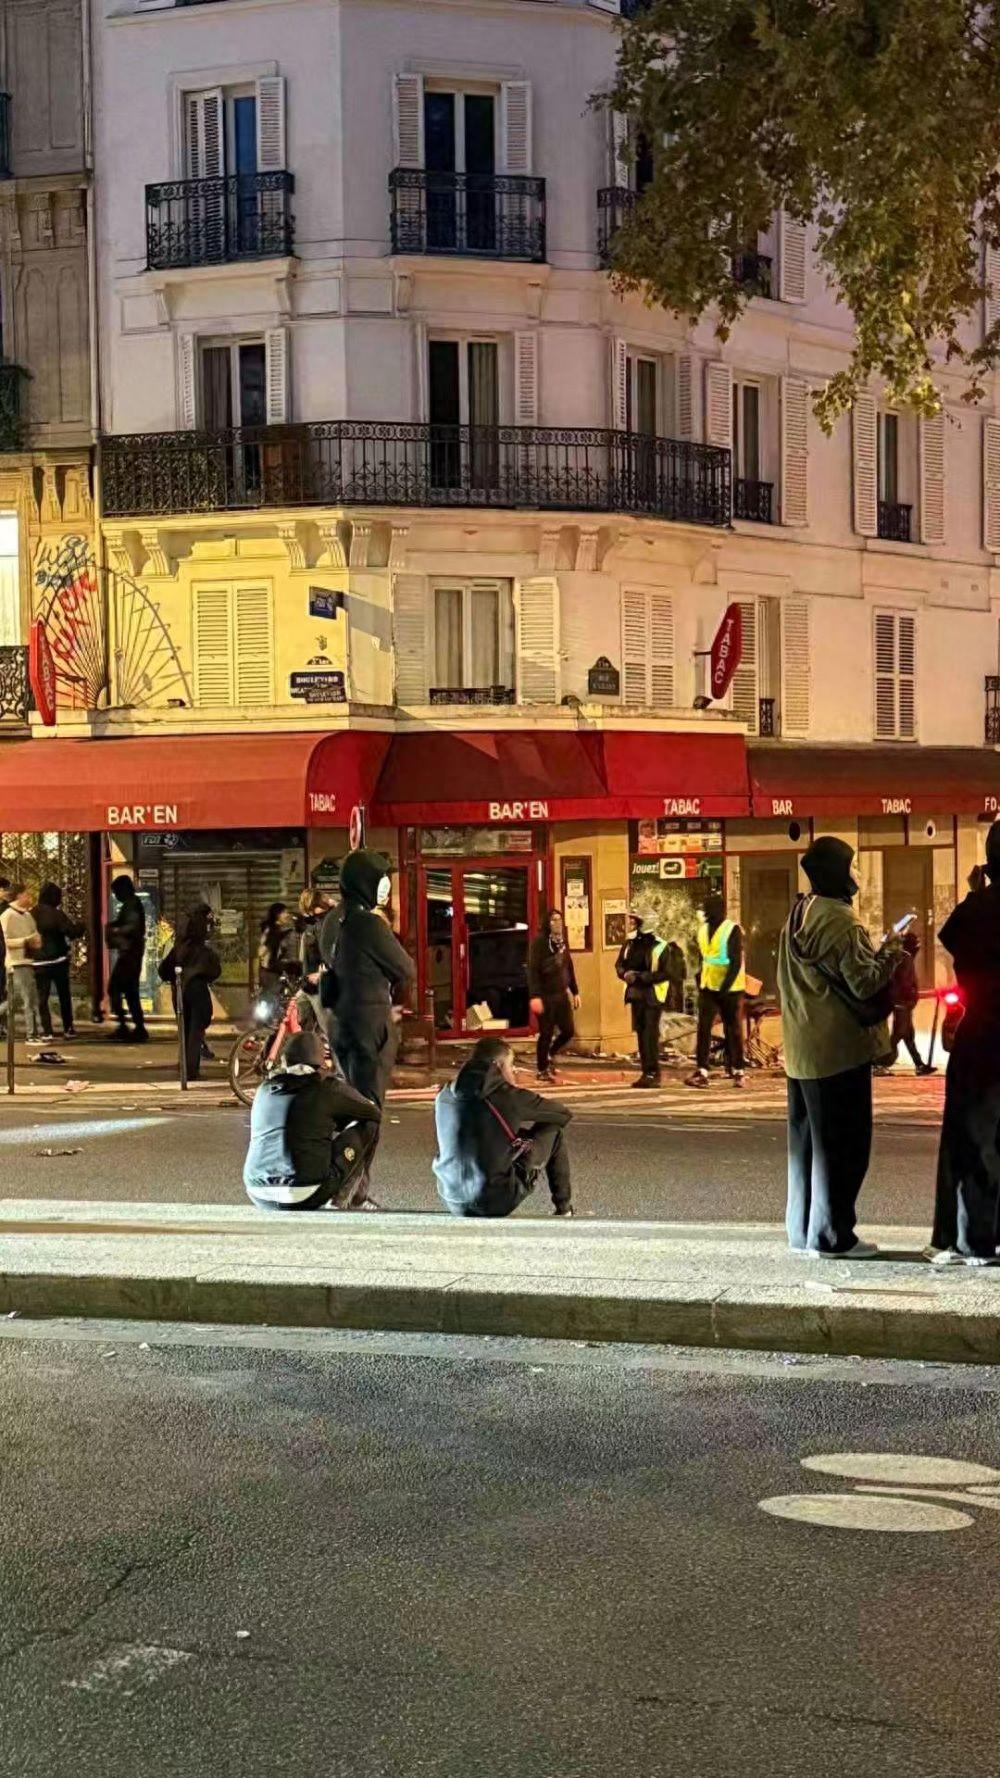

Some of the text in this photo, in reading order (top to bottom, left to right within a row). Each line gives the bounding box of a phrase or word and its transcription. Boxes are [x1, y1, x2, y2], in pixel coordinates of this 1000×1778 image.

[714, 619, 734, 683] TABAC
[308, 793, 335, 812] TABAC
[489, 801, 549, 819] BAR'EN
[664, 799, 700, 815] TABAC
[772, 800, 793, 815] BAR
[882, 799, 911, 814] TABAC
[106, 804, 178, 825] BAR'EN
